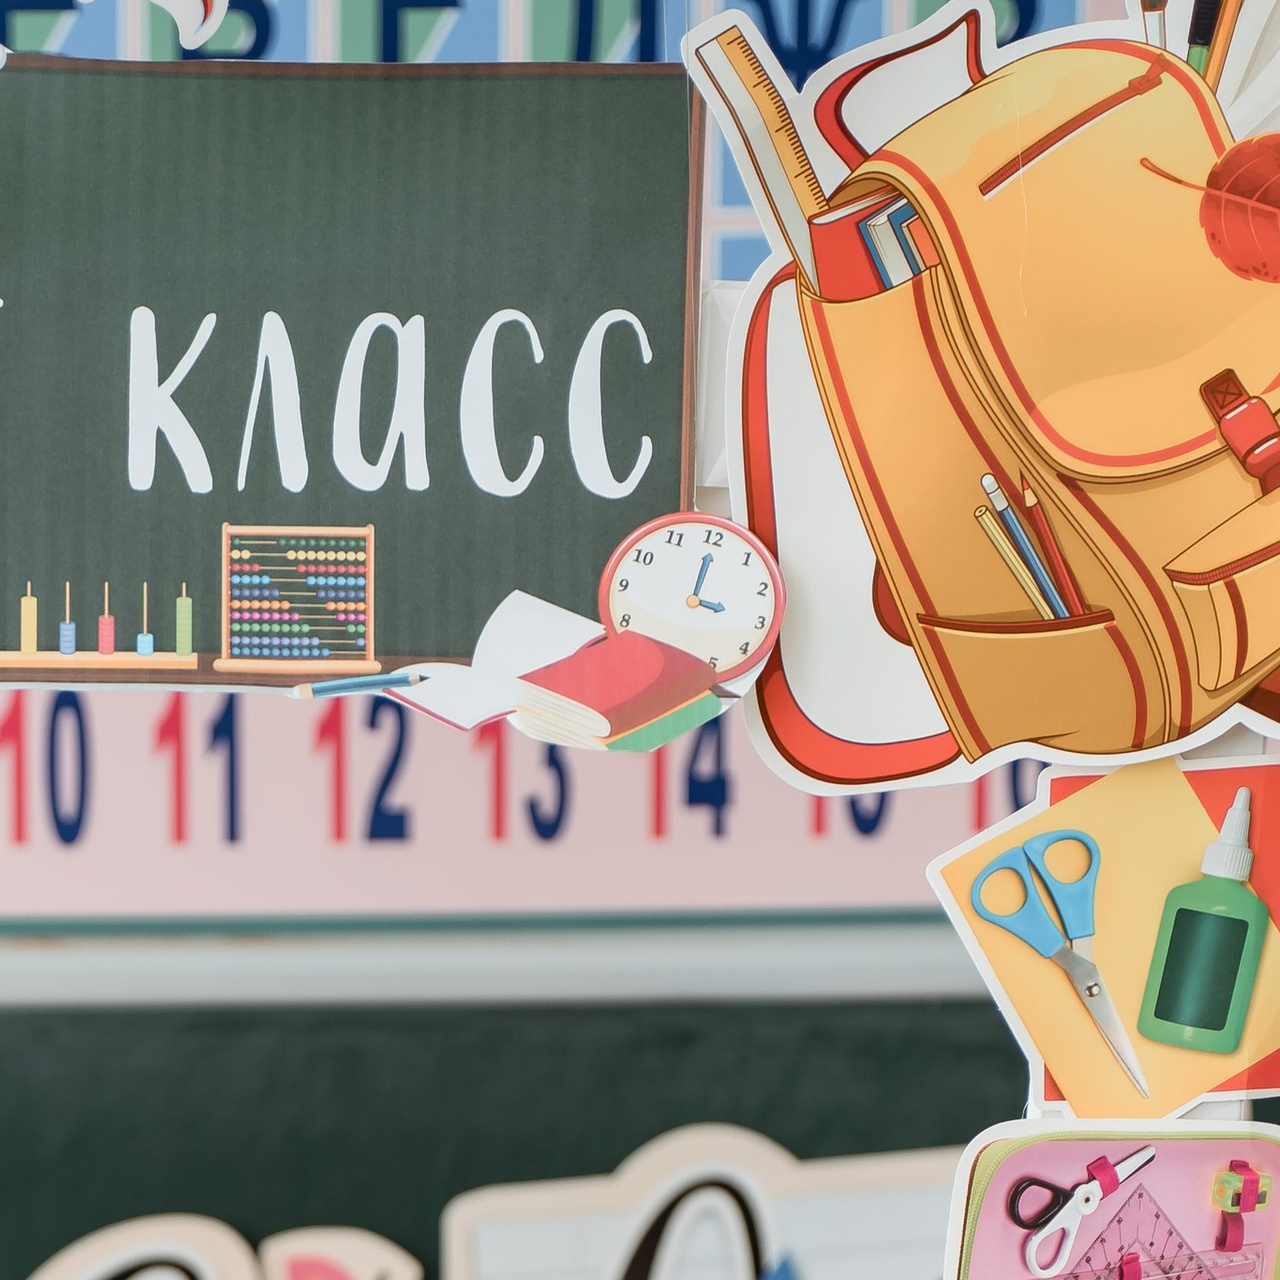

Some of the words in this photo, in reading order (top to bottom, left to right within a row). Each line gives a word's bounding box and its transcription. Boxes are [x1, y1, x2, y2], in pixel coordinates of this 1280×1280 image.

[127, 306, 653, 499] класс
[665, 530, 684, 547] 11
[703, 530, 723, 547] 12
[632, 549, 654, 565] 10
[742, 552, 751, 566] 1
[618, 579, 629, 592] 9
[757, 582, 768, 596] 2
[620, 614, 631, 628] 8
[755, 616, 765, 629] 3
[739, 642, 749, 655] 4
[153, 690, 245, 845] 11
[314, 693, 413, 843] 12
